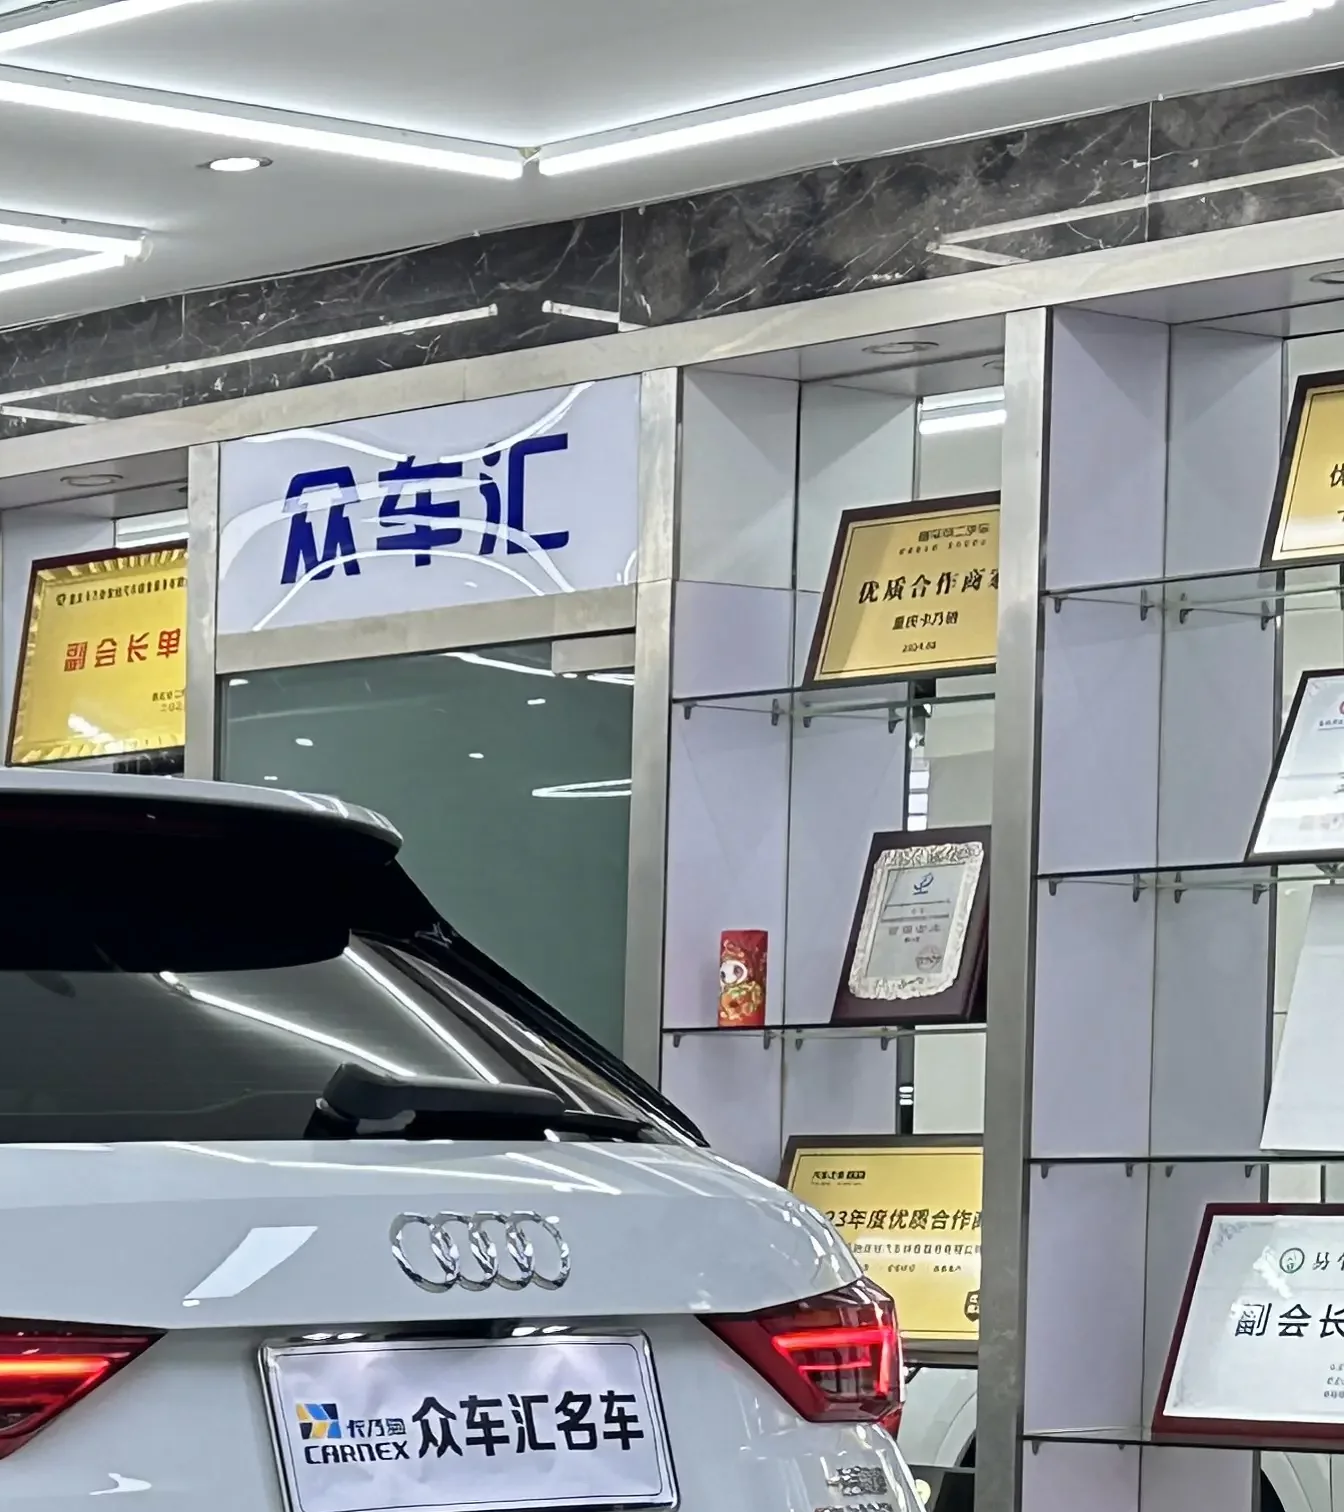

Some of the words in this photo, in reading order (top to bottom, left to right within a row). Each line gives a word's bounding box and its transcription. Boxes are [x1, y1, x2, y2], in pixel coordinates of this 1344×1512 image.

[280, 432, 569, 584] 众车汇
[304, 1440, 411, 1465] CARNEX
[412, 1390, 644, 1459] 众车汇名车
